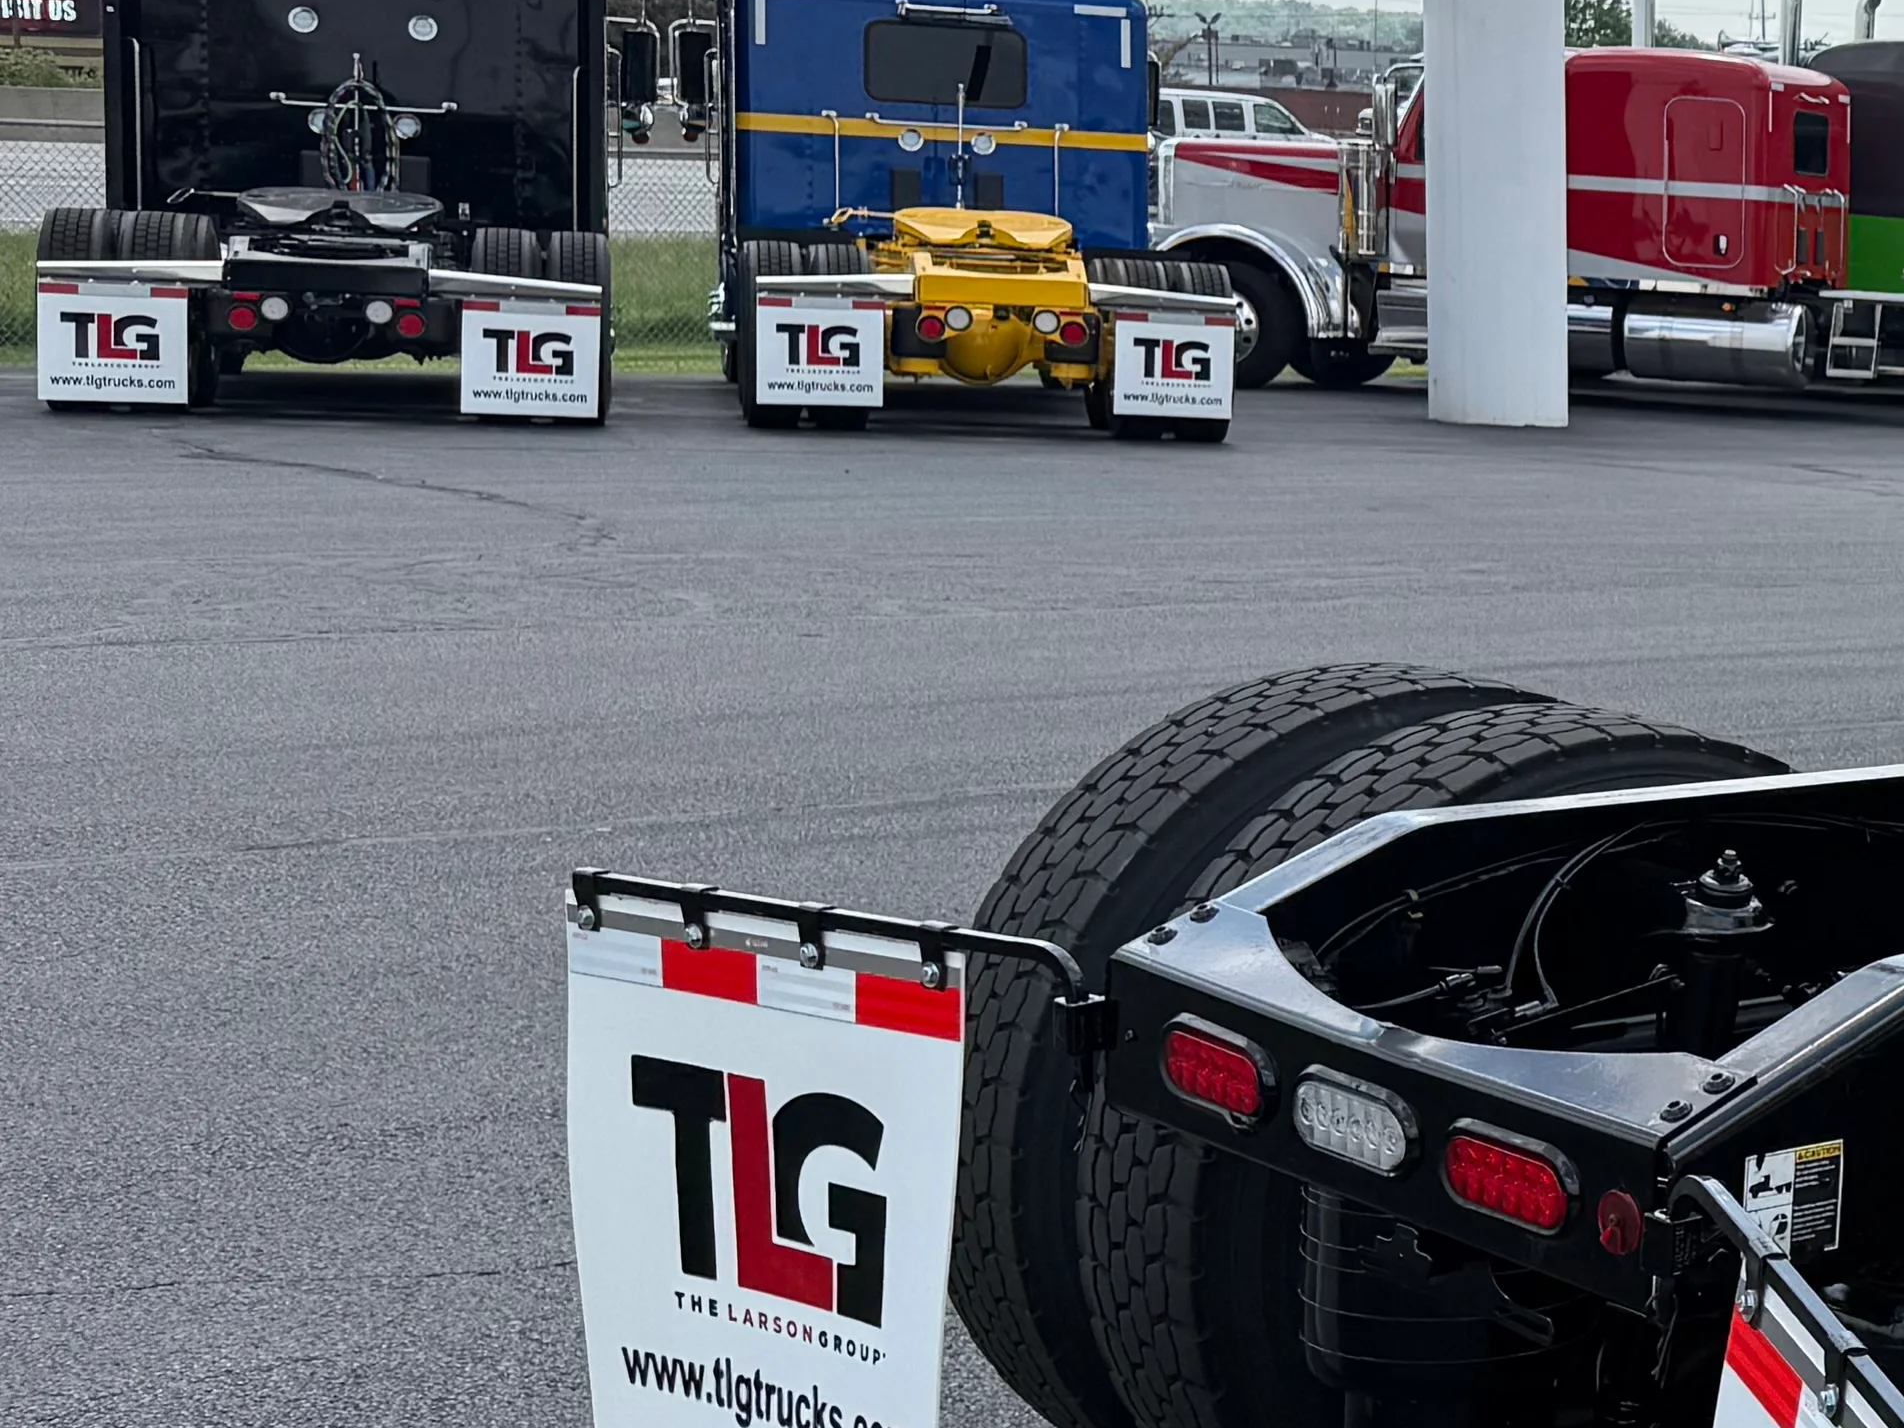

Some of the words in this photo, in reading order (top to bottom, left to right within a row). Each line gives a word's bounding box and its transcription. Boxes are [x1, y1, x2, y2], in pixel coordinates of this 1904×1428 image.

[48, 0, 77, 22] US
[59, 310, 161, 361] TLG
[482, 327, 575, 376] TLG
[775, 323, 861, 368] TLG
[1133, 337, 1212, 381] TLG
[49, 373, 176, 390] www.tlgtrucks.com
[472, 388, 588, 404] www.tlgtrucks.com
[767, 380, 874, 394] www.tlgtrucks.com
[1123, 392, 1223, 406] www.tlgtrucks.com
[630, 1054, 887, 1328] TLG
[674, 1290, 719, 1318] THE
[727, 1303, 813, 1345] LARSON
[818, 1329, 883, 1366] GROUP
